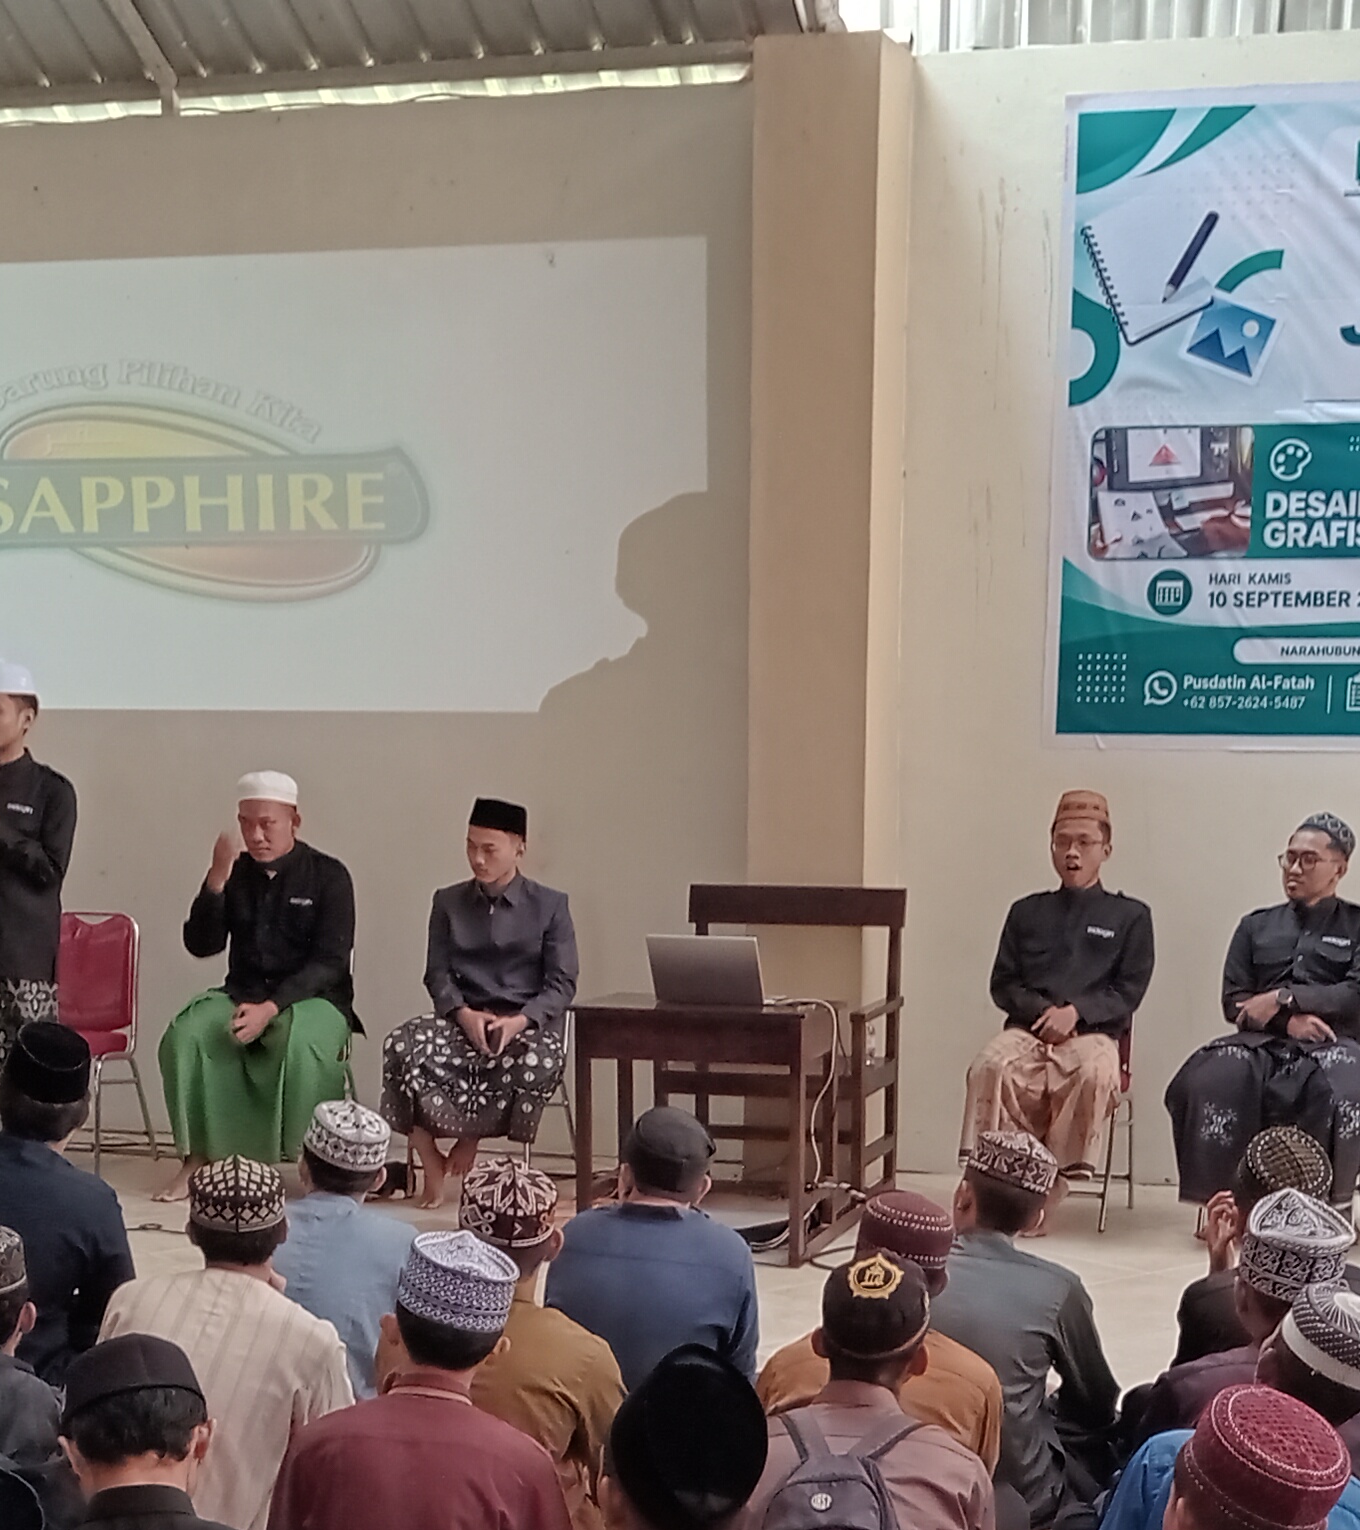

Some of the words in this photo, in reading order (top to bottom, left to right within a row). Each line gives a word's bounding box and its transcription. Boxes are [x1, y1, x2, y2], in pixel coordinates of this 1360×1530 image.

[117, 357, 240, 408] Pilihan
[245, 391, 322, 444] Kita
[1208, 573, 1241, 585] HARI
[1248, 572, 1292, 585] KAMIS
[1208, 591, 1227, 608] 10
[1232, 590, 1351, 608] SEPTEMBER
[1183, 673, 1247, 690] Pusdatin
[1249, 674, 1315, 691] Al-Fatah
